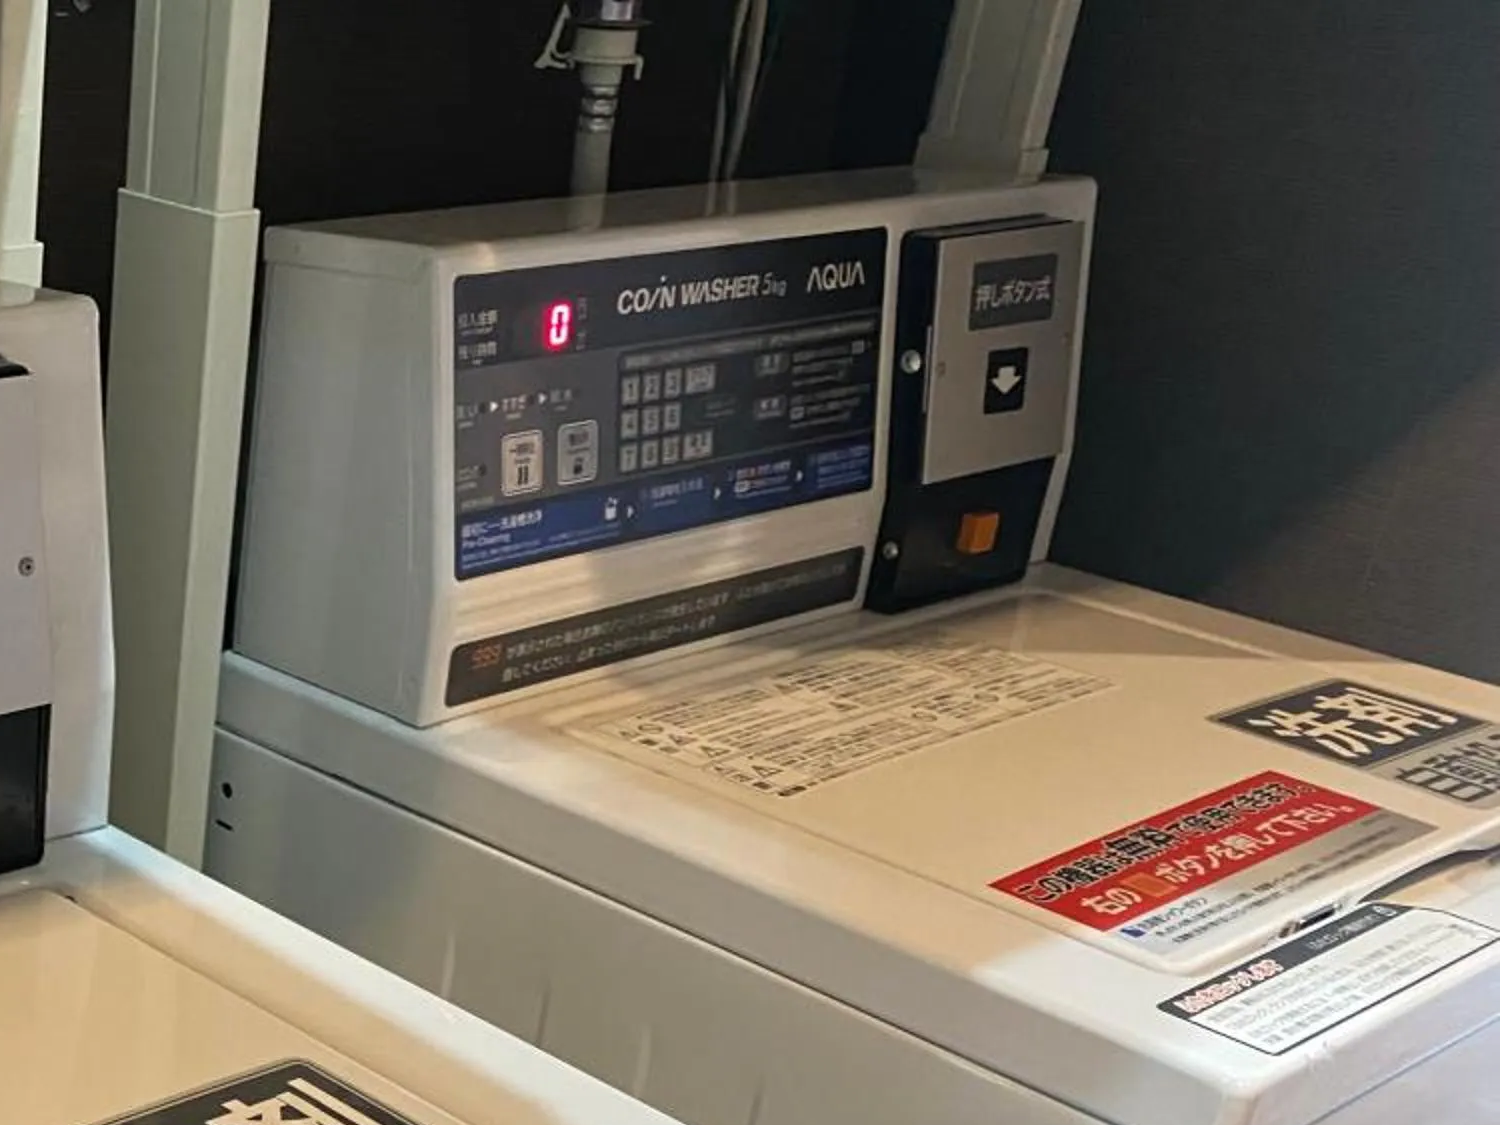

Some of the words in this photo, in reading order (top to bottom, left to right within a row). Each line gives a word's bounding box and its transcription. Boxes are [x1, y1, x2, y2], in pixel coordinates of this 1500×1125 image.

[616, 275, 676, 315] COIN
[681, 273, 760, 307] WASHER
[806, 261, 866, 293] AQUA
[549, 303, 571, 345] 0
[1247, 687, 1458, 758] 洗剤
